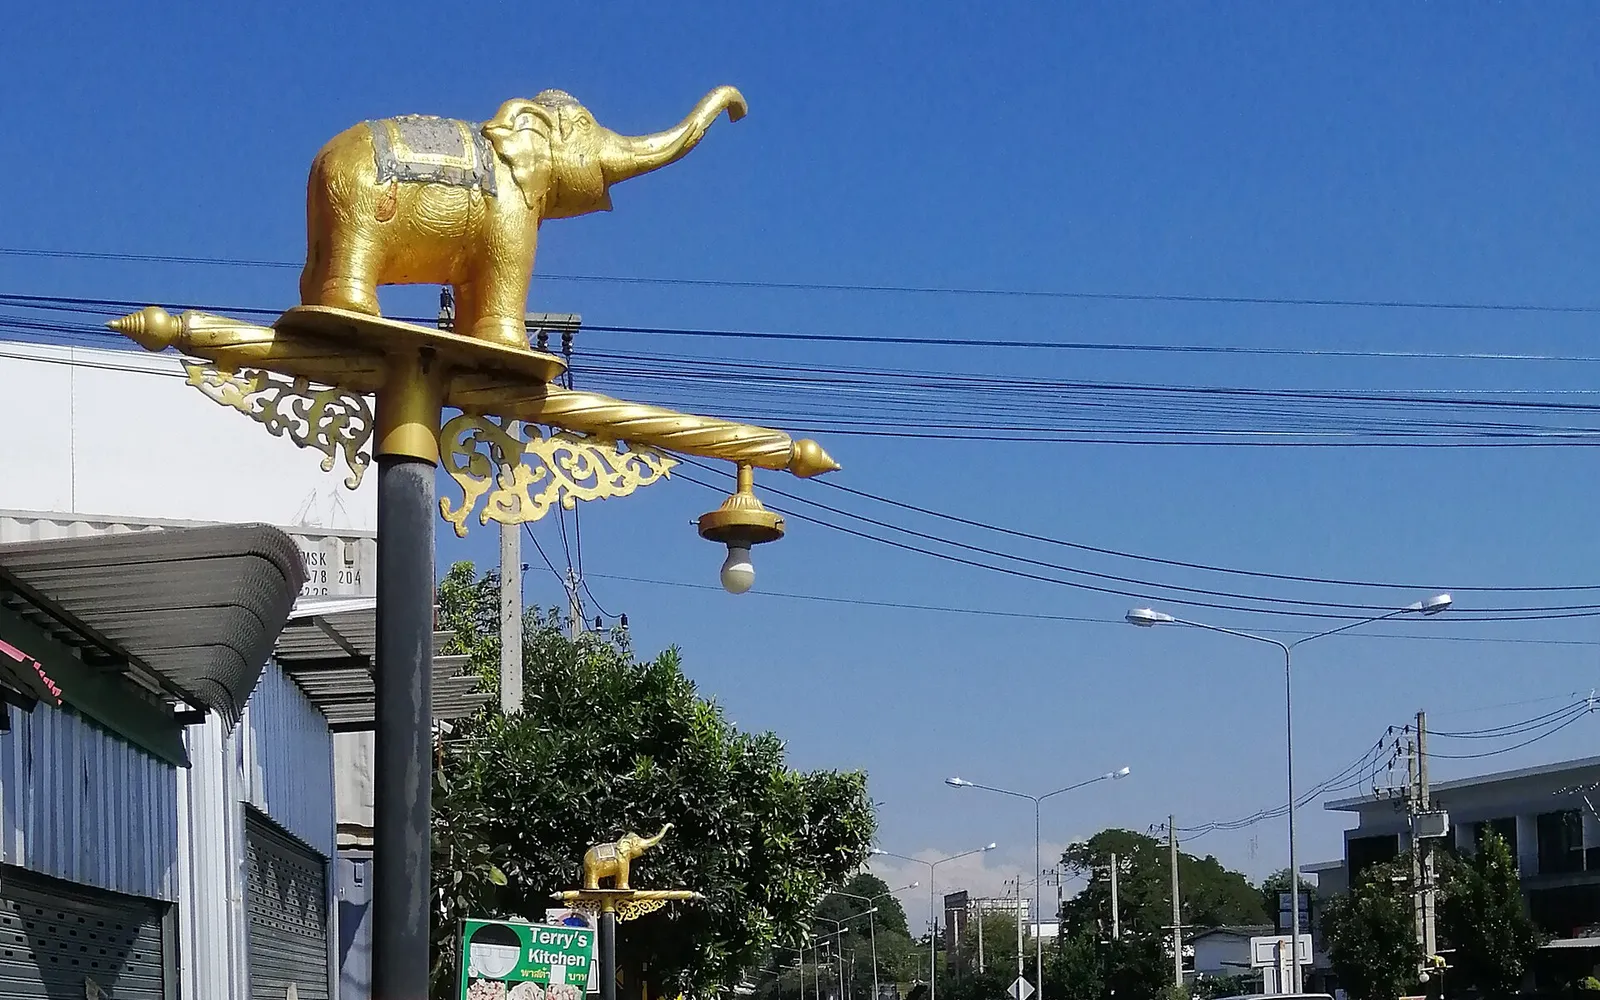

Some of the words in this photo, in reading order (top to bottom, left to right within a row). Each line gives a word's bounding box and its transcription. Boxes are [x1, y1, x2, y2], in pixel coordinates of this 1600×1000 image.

[338, 570, 361, 587] 204
[529, 927, 588, 949] Terry's
[528, 948, 586, 967] Kitchen
